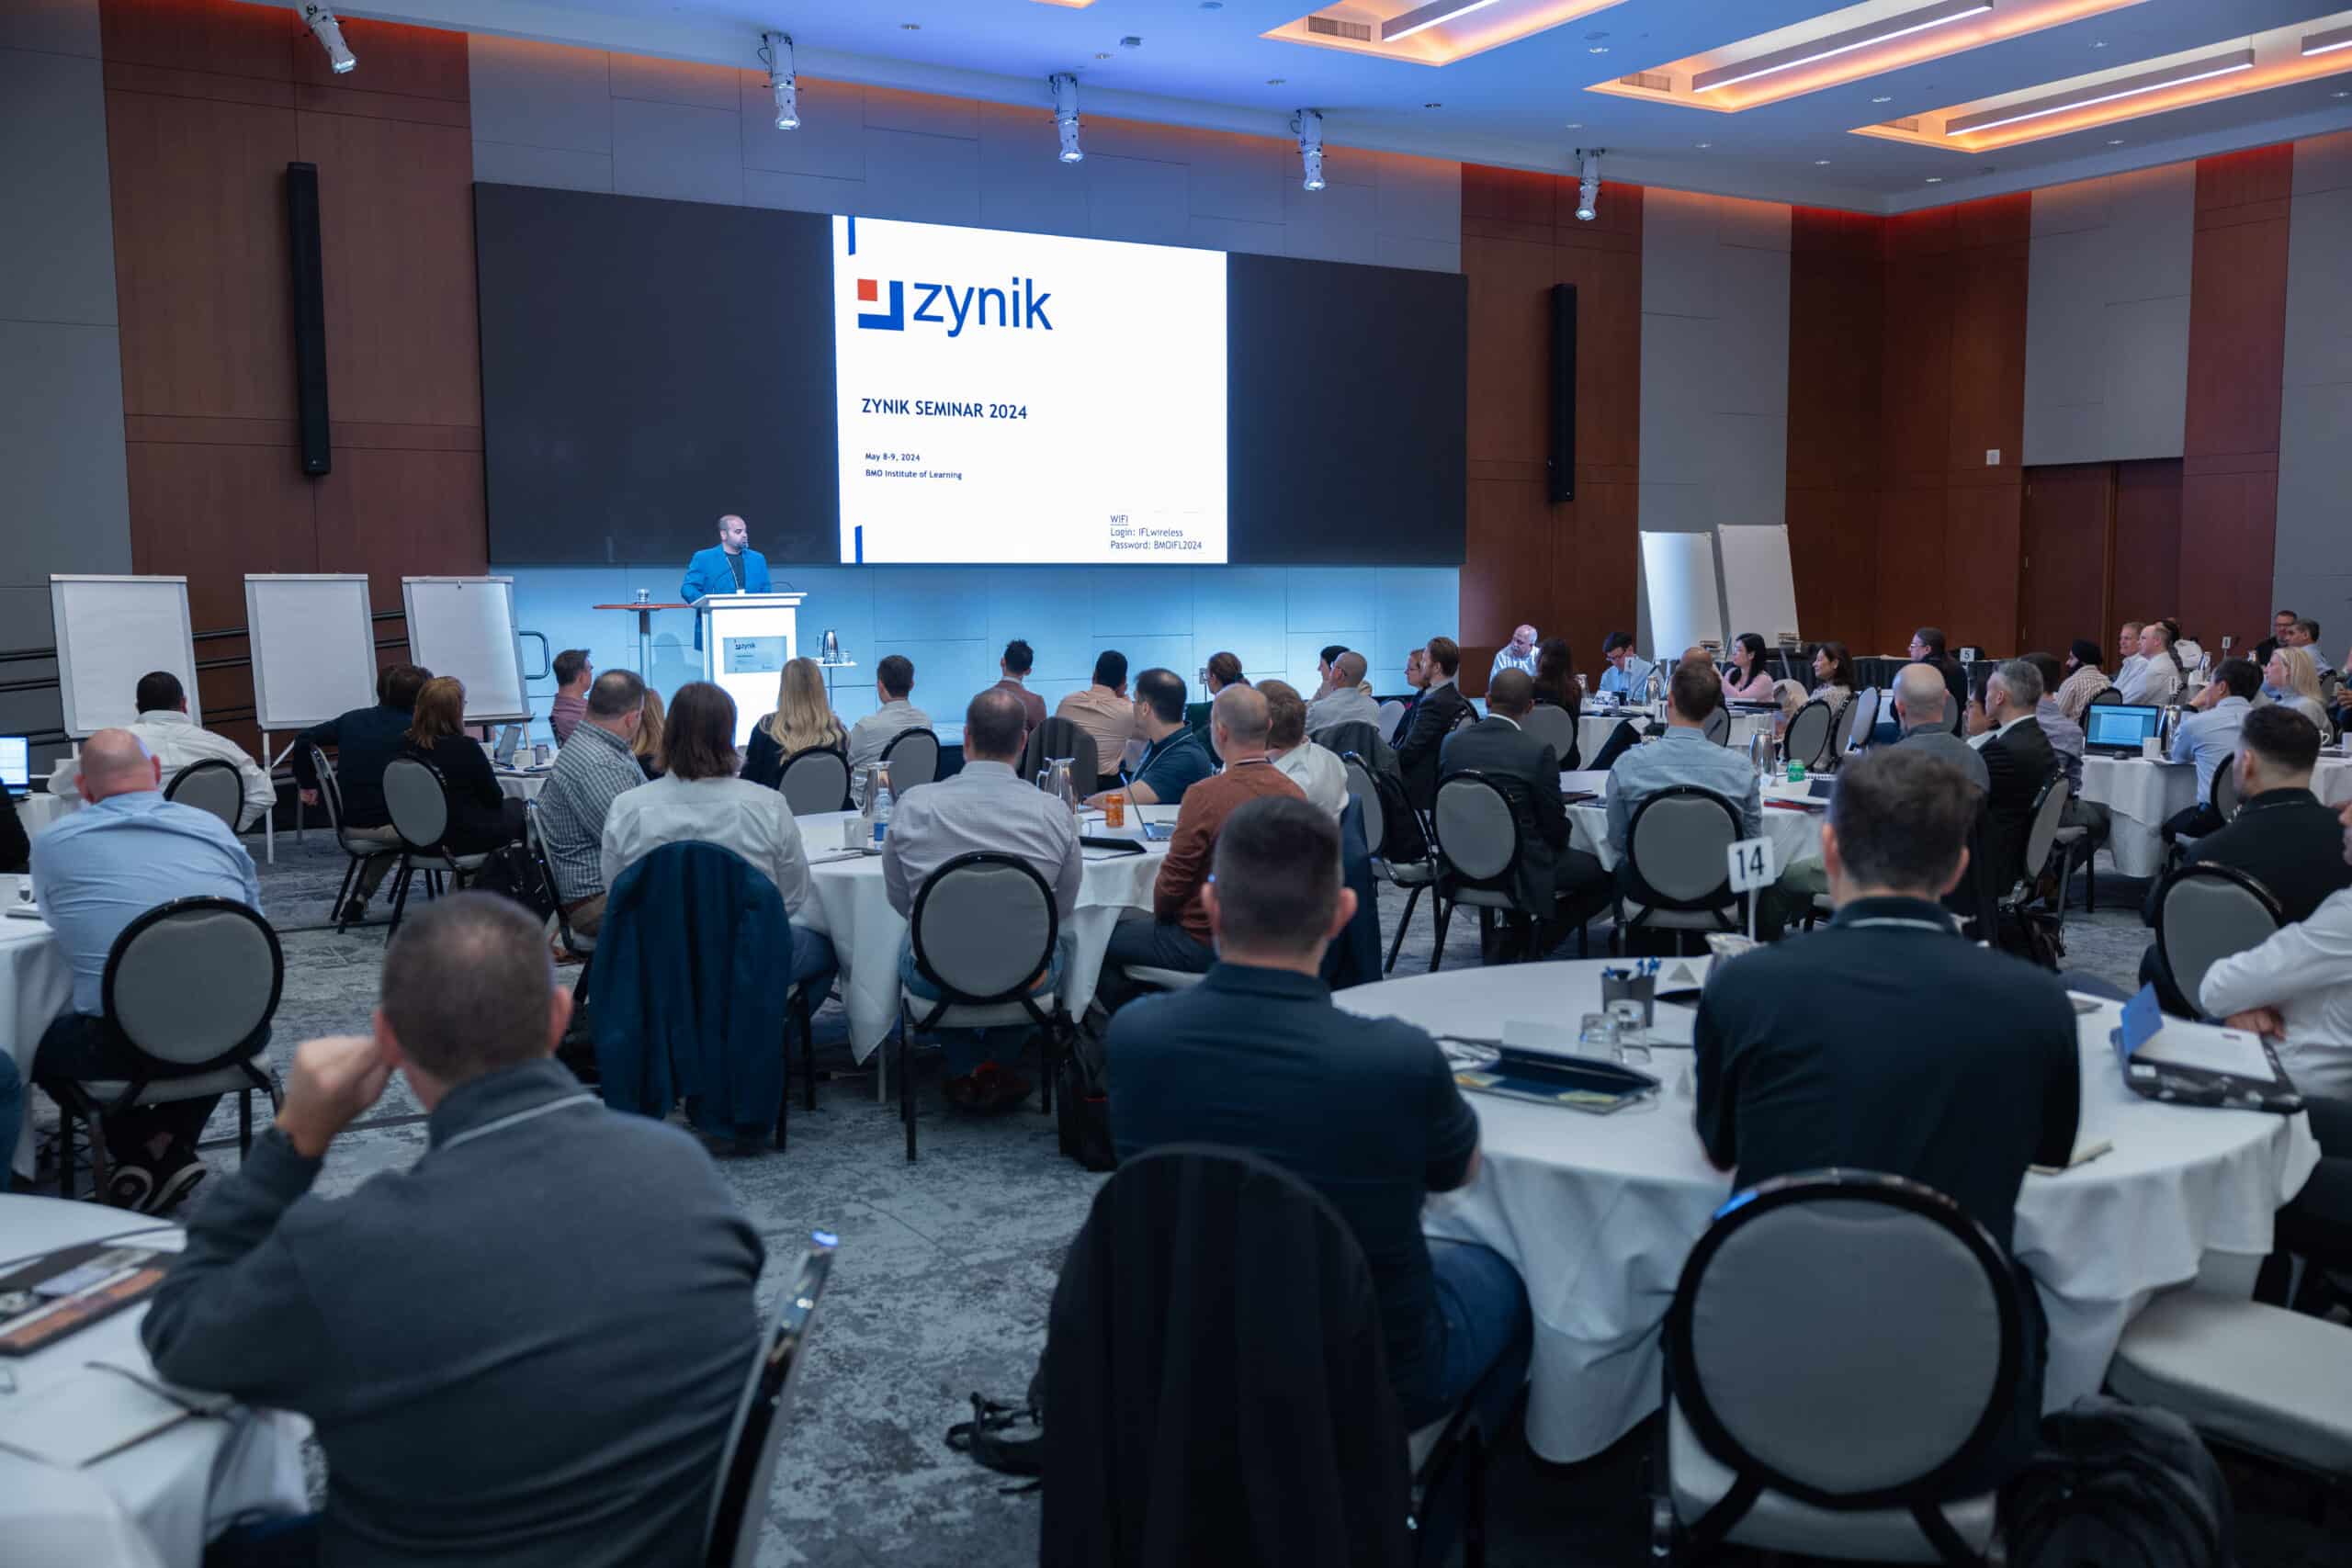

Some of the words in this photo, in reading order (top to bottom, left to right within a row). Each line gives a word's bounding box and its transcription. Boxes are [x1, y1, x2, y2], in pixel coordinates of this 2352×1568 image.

[912, 276, 1054, 339] zynik
[861, 397, 910, 416] ZYNIK
[914, 400, 985, 419] SEMINAR
[989, 402, 1029, 420] 2024
[865, 452, 881, 463] May
[882, 452, 899, 462] 8-9,
[900, 453, 921, 462] 2024
[865, 468, 883, 478] BMO
[884, 469, 918, 479] Institute
[919, 469, 928, 479] of
[929, 470, 963, 481] Learning
[1110, 527, 1136, 538] Login:
[1138, 527, 1184, 537] IFLwireless
[1110, 539, 1151, 550] Password:
[1153, 539, 1203, 550] BMOIFL2024
[1963, 649, 1971, 660] 5
[1736, 845, 1766, 880] 14
